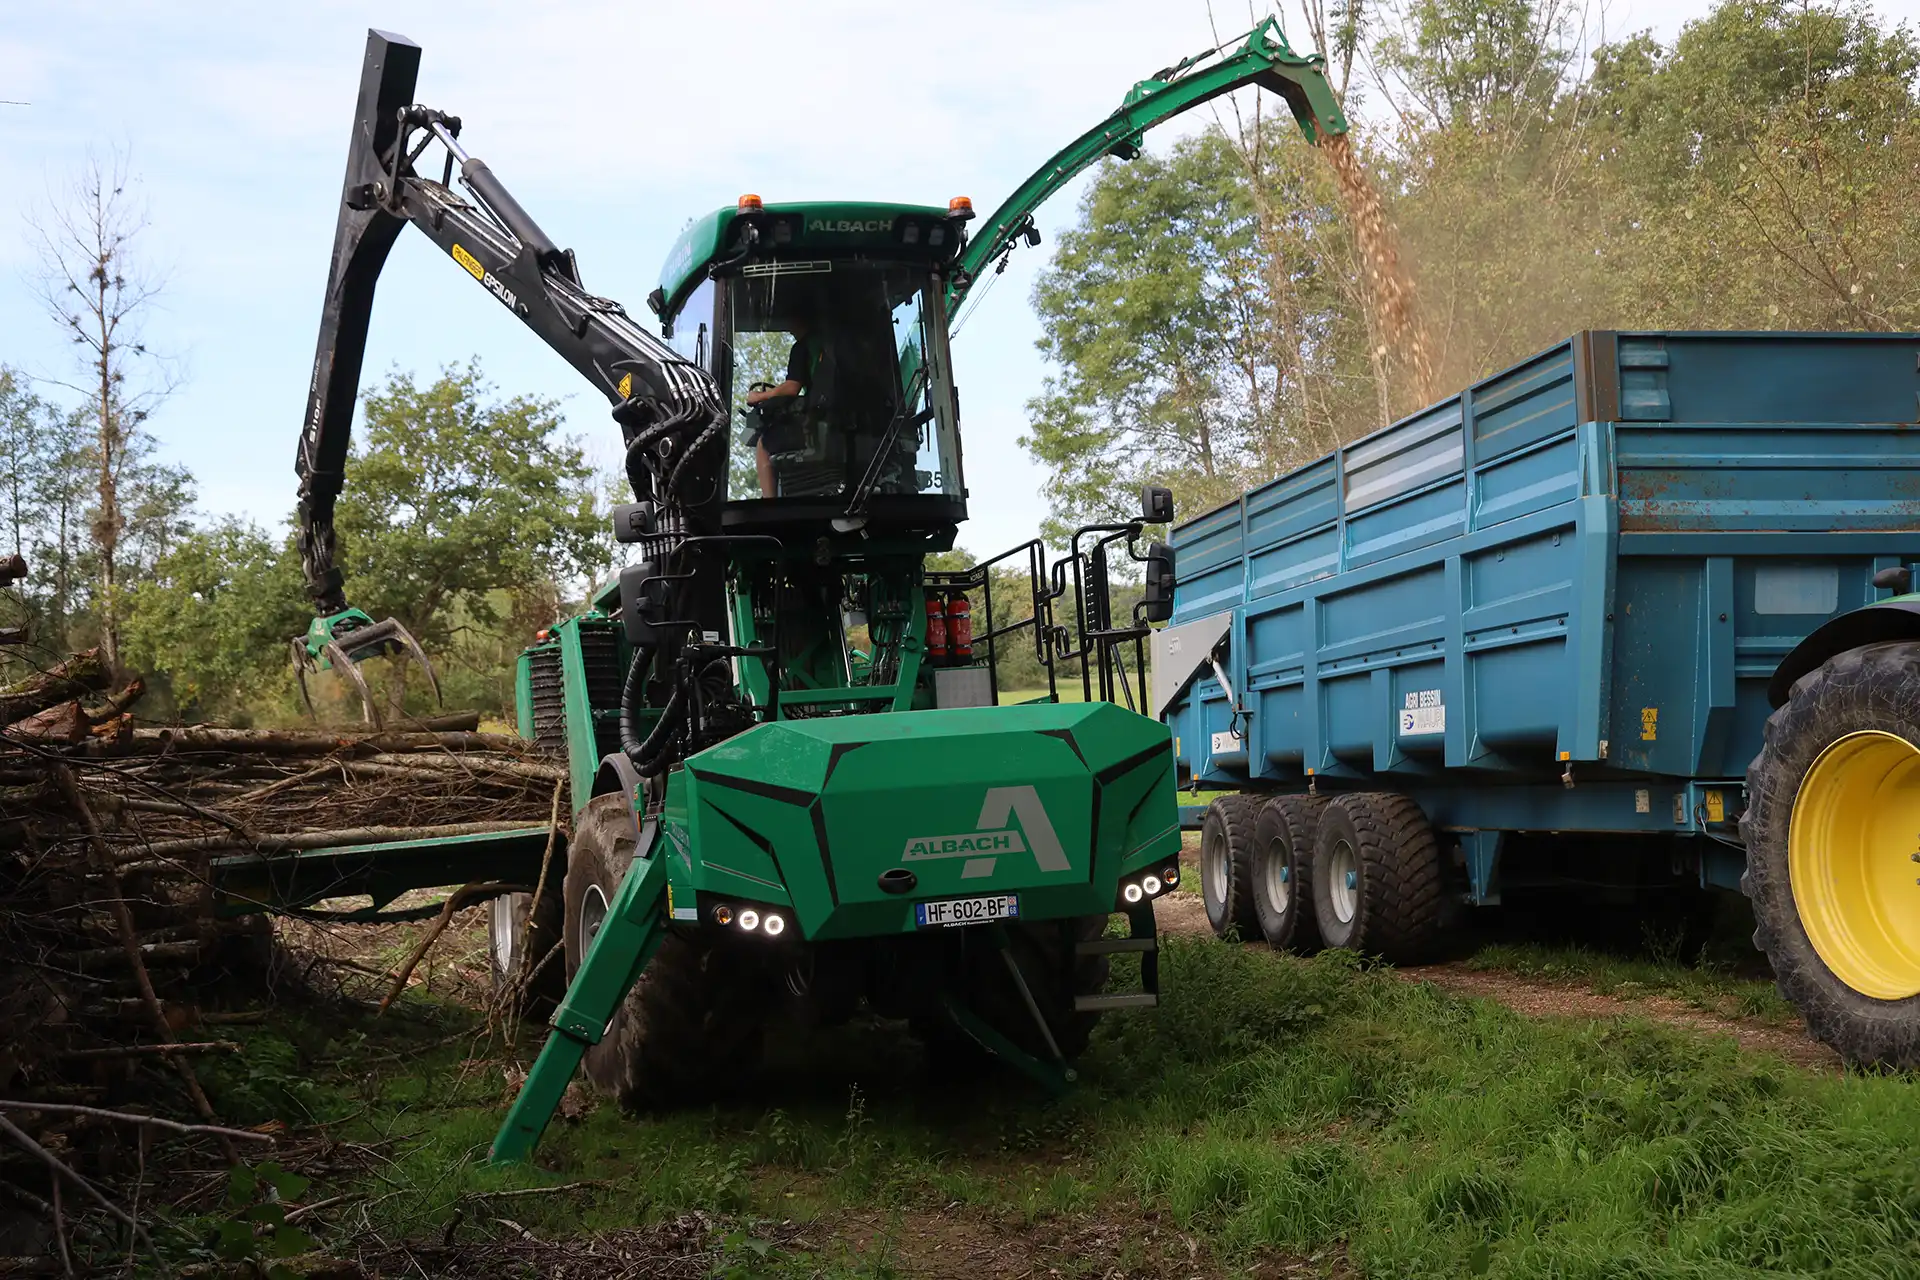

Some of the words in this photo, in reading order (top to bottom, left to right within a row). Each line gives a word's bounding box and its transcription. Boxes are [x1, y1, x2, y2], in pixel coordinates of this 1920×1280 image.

[808, 219, 893, 232] ALBACH
[483, 272, 517, 309] EPSILON
[1405, 691, 1419, 709] AGRI
[1419, 689, 1441, 708] BESSIN
[909, 835, 1010, 856] ALBACH
[927, 897, 1007, 923] HF-602-BF
